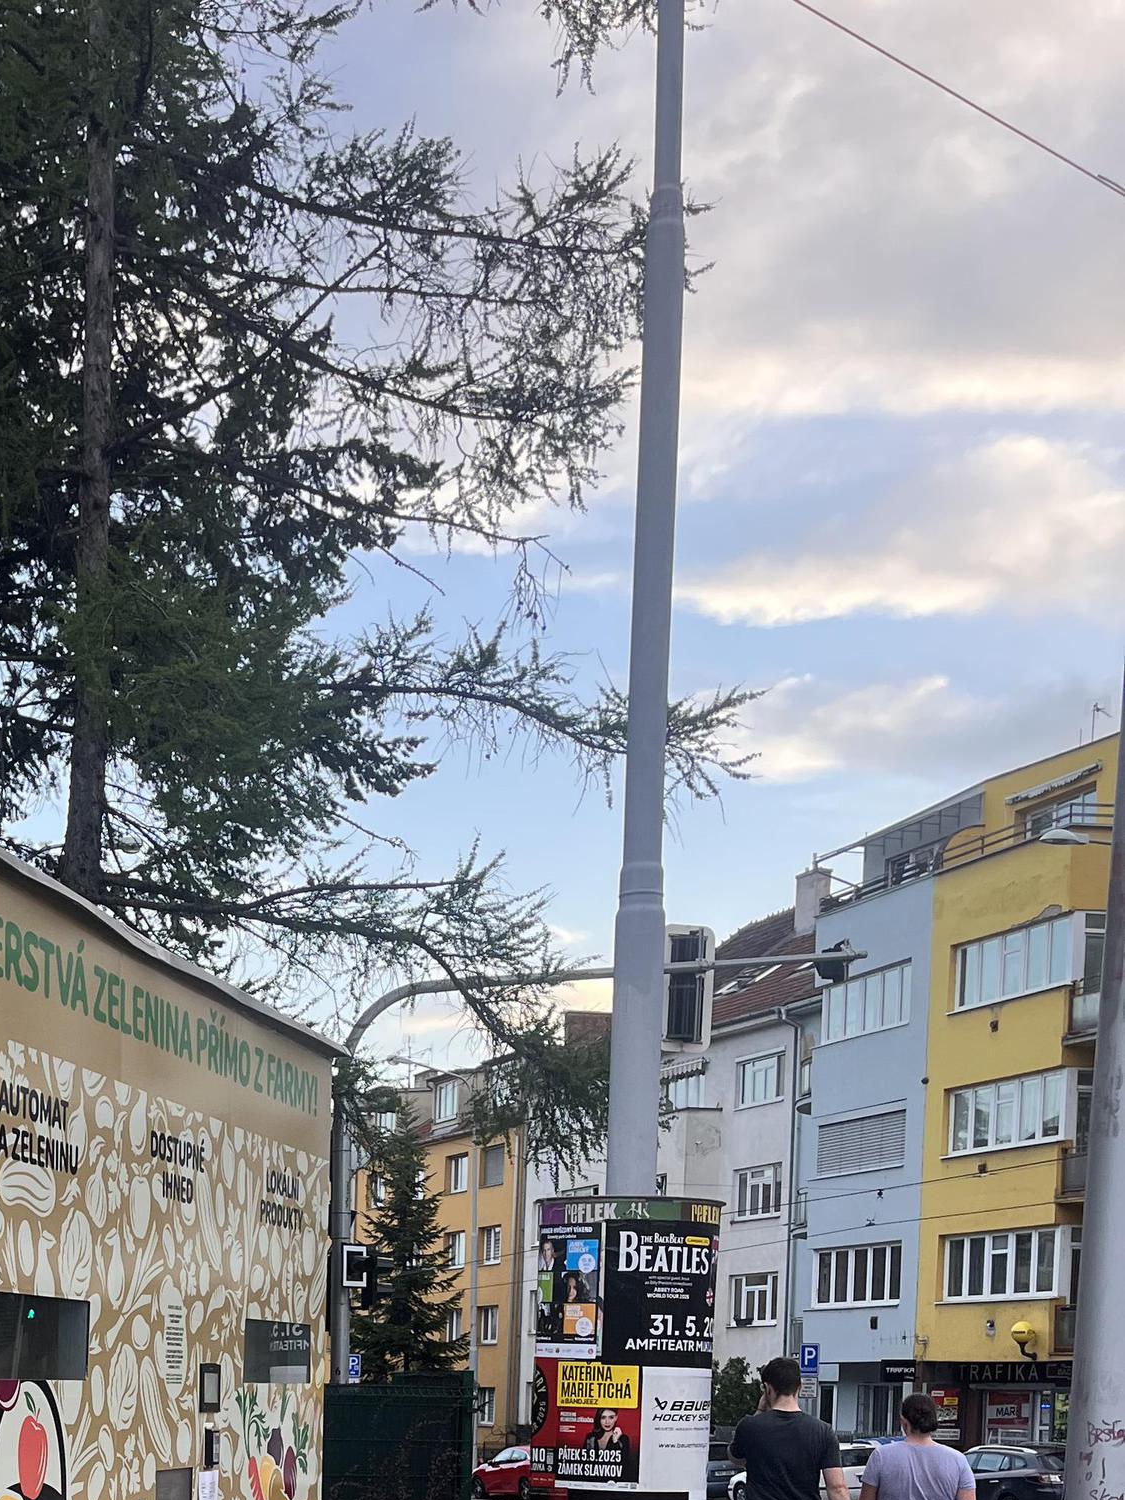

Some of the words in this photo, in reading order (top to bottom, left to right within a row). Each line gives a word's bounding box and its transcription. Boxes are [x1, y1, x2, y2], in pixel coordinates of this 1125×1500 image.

[93, 965, 193, 1062] ZELENINA
[196, 1007, 250, 1088] PŘÍMO
[254, 1046, 264, 1094] Z
[266, 1051, 319, 1118] FARMY!
[11, 1128, 79, 1175] ZELENINU
[150, 1130, 205, 1173] DOSTUPNÉ
[162, 1171, 194, 1204] IHNED
[265, 1170, 300, 1202] LOKÁLNÍ
[260, 1200, 304, 1231] PRODUKTY
[641, 1235, 653, 1245] THE
[617, 1231, 709, 1275] BEATLES
[649, 1314, 680, 1336] 31.
[684, 1315, 700, 1337] 5.
[625, 1338, 695, 1352] AMFITEATR
[349, 1357, 359, 1369] P
[805, 1347, 816, 1366] P
[958, 1363, 1040, 1382] TRAFIKA
[561, 1382, 594, 1398] MARIE
[597, 1379, 632, 1399] TICHÁ
[652, 1413, 698, 1421] HOCKEY
[558, 1445, 581, 1461] PÁTEK
[581, 1448, 622, 1463] 5.9.2025
[558, 1460, 583, 1476] ZÁMEK
[584, 1464, 623, 1477] SLAVKOV
